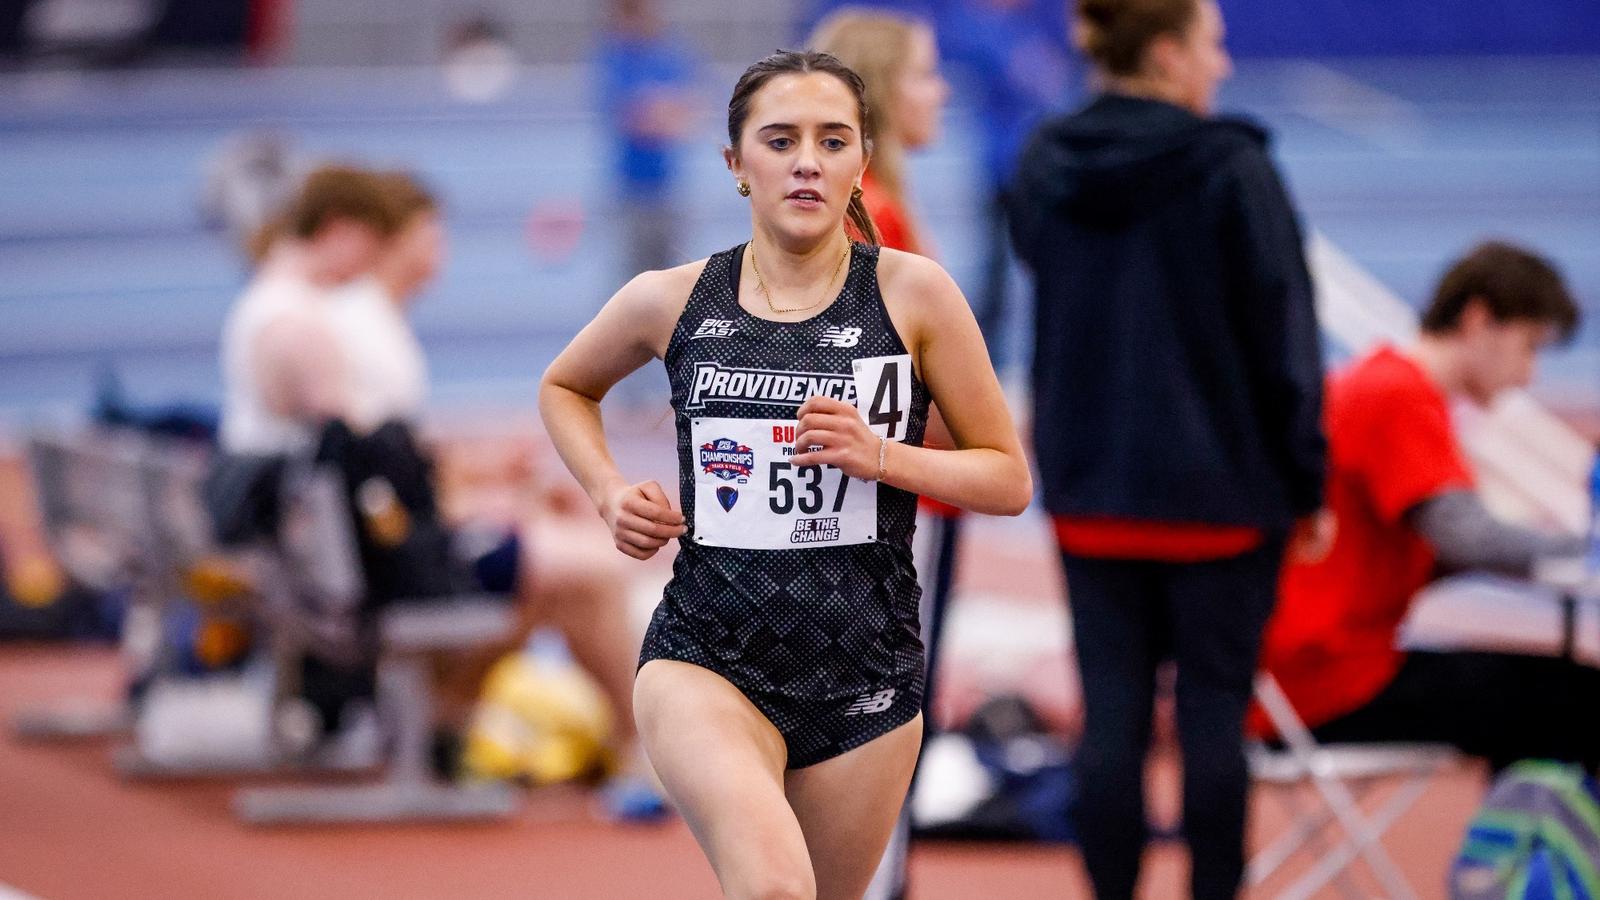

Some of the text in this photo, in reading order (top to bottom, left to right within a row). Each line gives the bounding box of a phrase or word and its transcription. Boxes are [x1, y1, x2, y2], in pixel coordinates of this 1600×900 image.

[701, 318, 734, 328] BIG
[694, 327, 740, 337] EAST
[691, 365, 858, 404] PROVIDENCE
[868, 362, 903, 438] 4
[701, 451, 753, 466] CHAMPIONSHIPS
[769, 462, 850, 515] 537
[796, 518, 839, 531] BE THE
[791, 529, 840, 543] CHANGE
